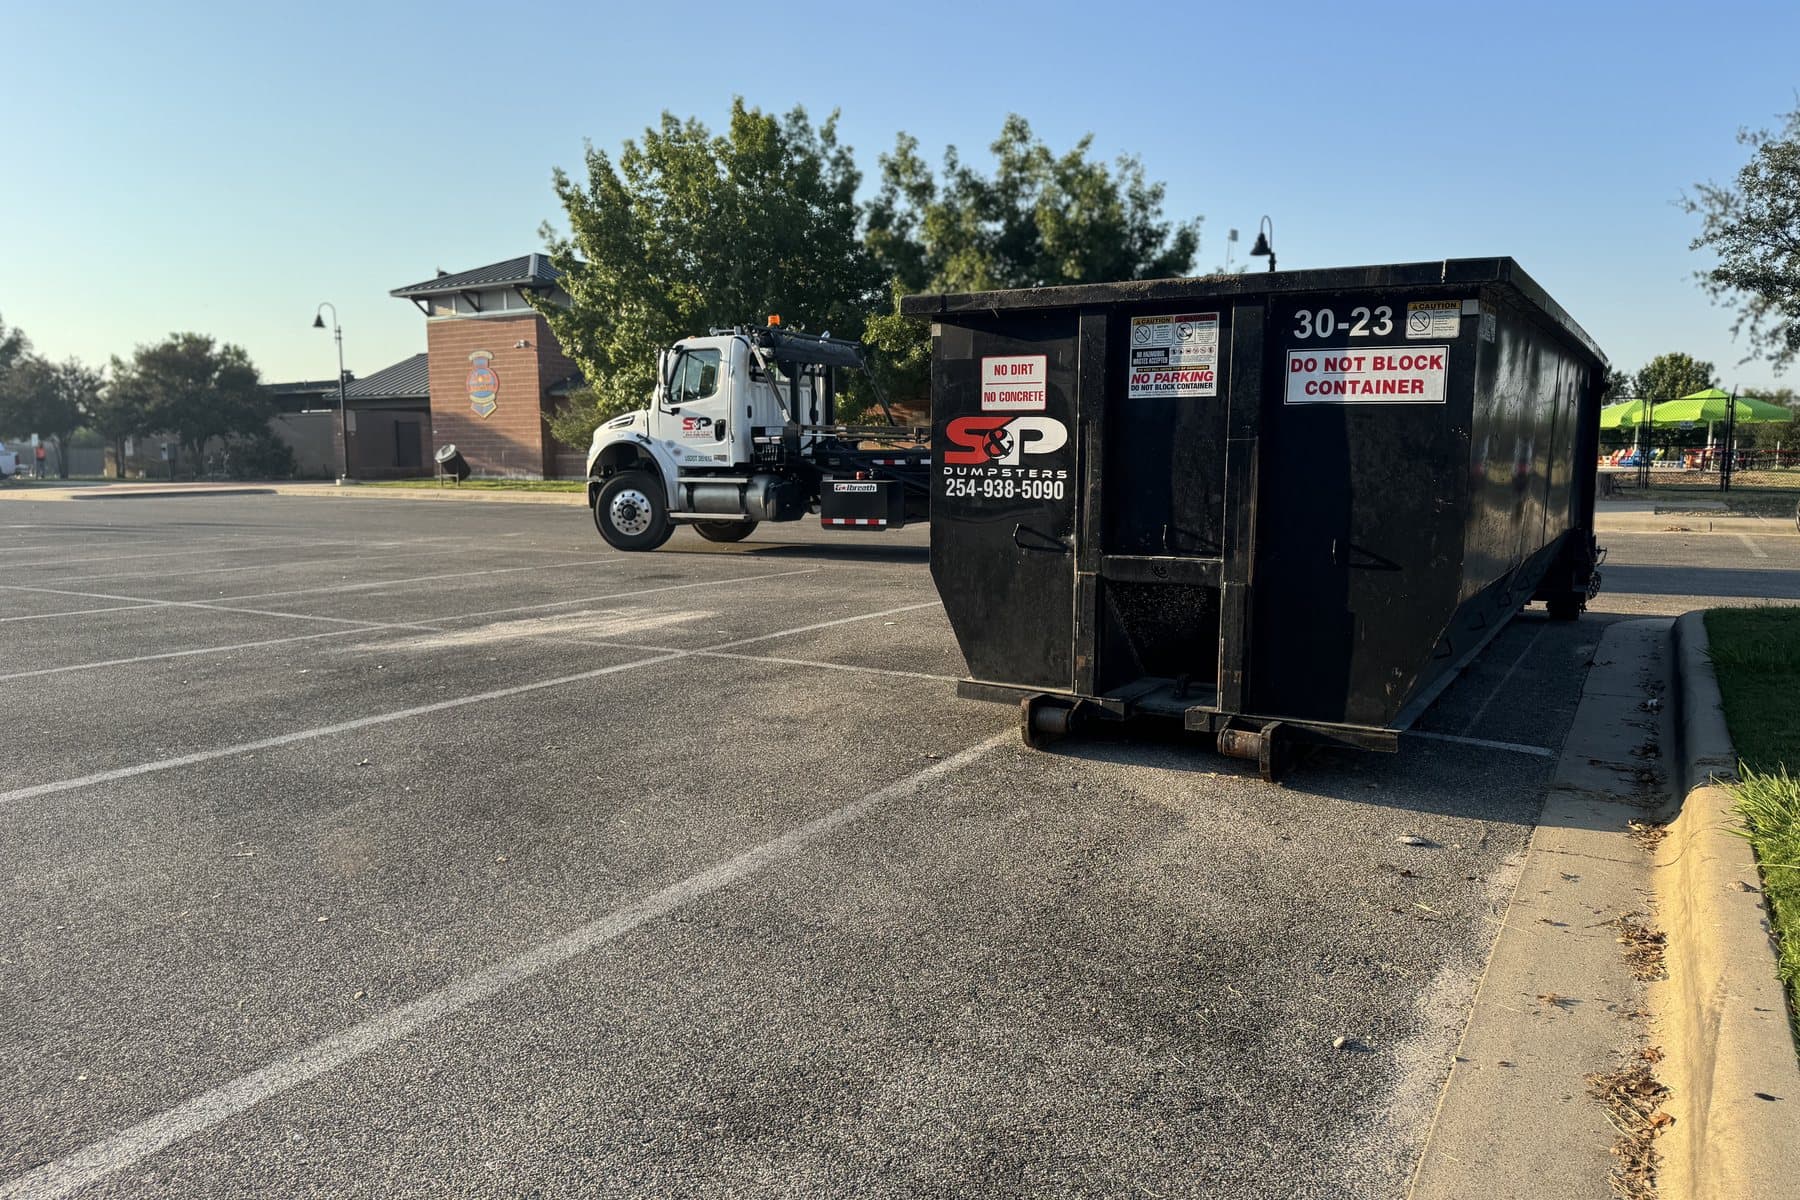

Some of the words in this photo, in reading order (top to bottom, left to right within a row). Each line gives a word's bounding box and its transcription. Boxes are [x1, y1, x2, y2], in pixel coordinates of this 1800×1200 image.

[1419, 302, 1457, 310] CAUTION
[1293, 305, 1394, 339] 30-23
[994, 364, 1008, 376] NO
[1011, 363, 1034, 376] DIRT
[1290, 357, 1318, 373] DO
[1324, 356, 1366, 372] NOT
[1372, 354, 1444, 371] BLOCK
[1131, 373, 1151, 385] NO
[1153, 370, 1214, 383] PARKING
[1141, 383, 1153, 391] NOT
[1176, 382, 1213, 390] CONTAINER
[1305, 378, 1425, 395] CONTAINER
[983, 391, 996, 403] NO
[999, 390, 1044, 402] CONCRETE
[943, 416, 1068, 465] S&P
[943, 466, 1068, 479] DUMPSTERS
[945, 478, 1064, 500] 254-938-5090
